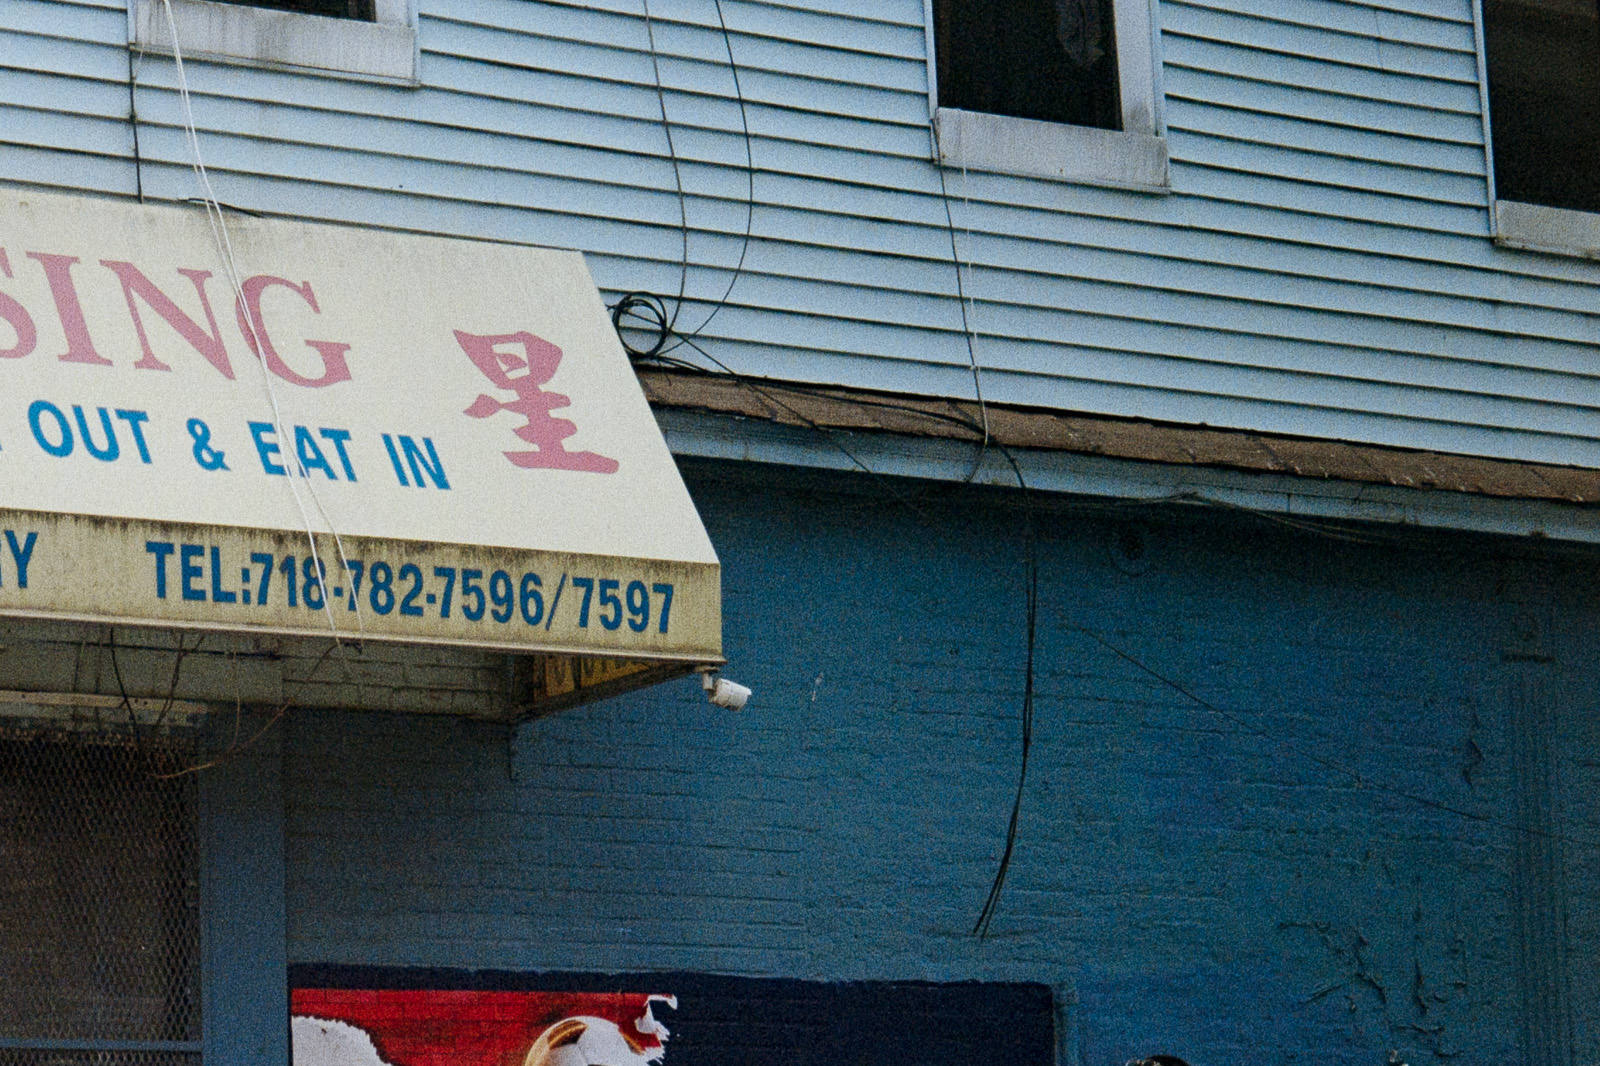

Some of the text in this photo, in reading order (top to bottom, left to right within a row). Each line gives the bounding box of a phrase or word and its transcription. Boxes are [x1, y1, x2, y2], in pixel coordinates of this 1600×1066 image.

[26, 398, 155, 466] OUT
[184, 416, 231, 473] &
[246, 419, 360, 484] EAT
[379, 431, 453, 492] IN
